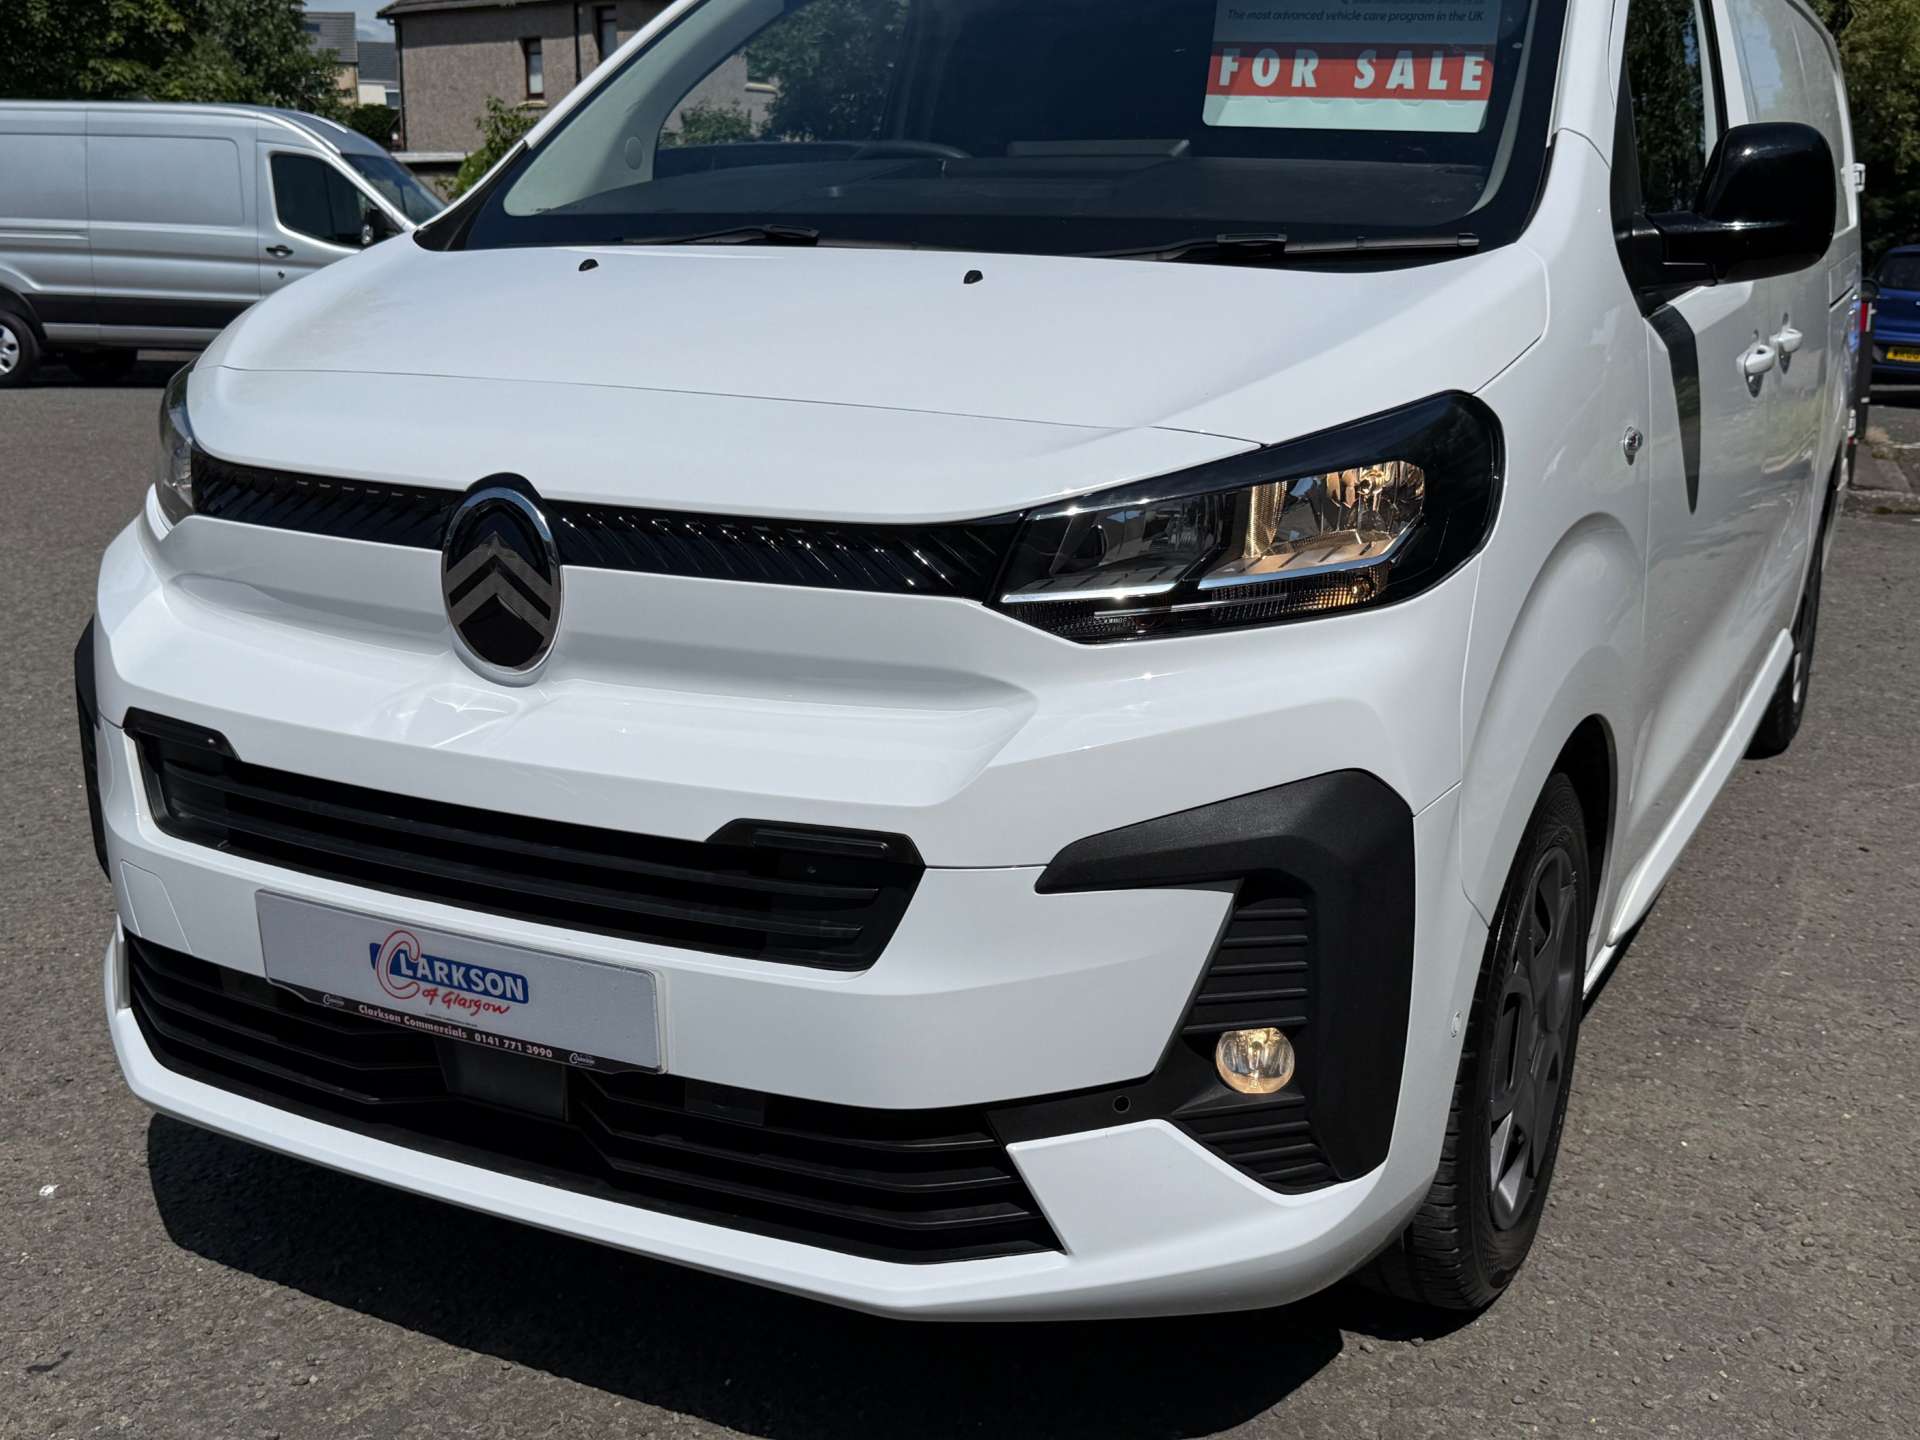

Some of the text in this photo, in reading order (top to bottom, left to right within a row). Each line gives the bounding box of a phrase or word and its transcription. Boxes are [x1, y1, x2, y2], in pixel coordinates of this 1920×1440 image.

[1228, 8, 1484, 24] The most advanced vehicle care program in the UK
[1218, 48, 1485, 91] FOR SALE
[377, 930, 524, 1001] CLARKSON
[422, 986, 511, 1017] of Glasgow
[358, 1004, 401, 1023] Clarkson
[404, 1014, 468, 1039] Commercials
[474, 1032, 500, 1047] 0141
[504, 1039, 522, 1052] 771
[526, 1044, 553, 1058] 3990
